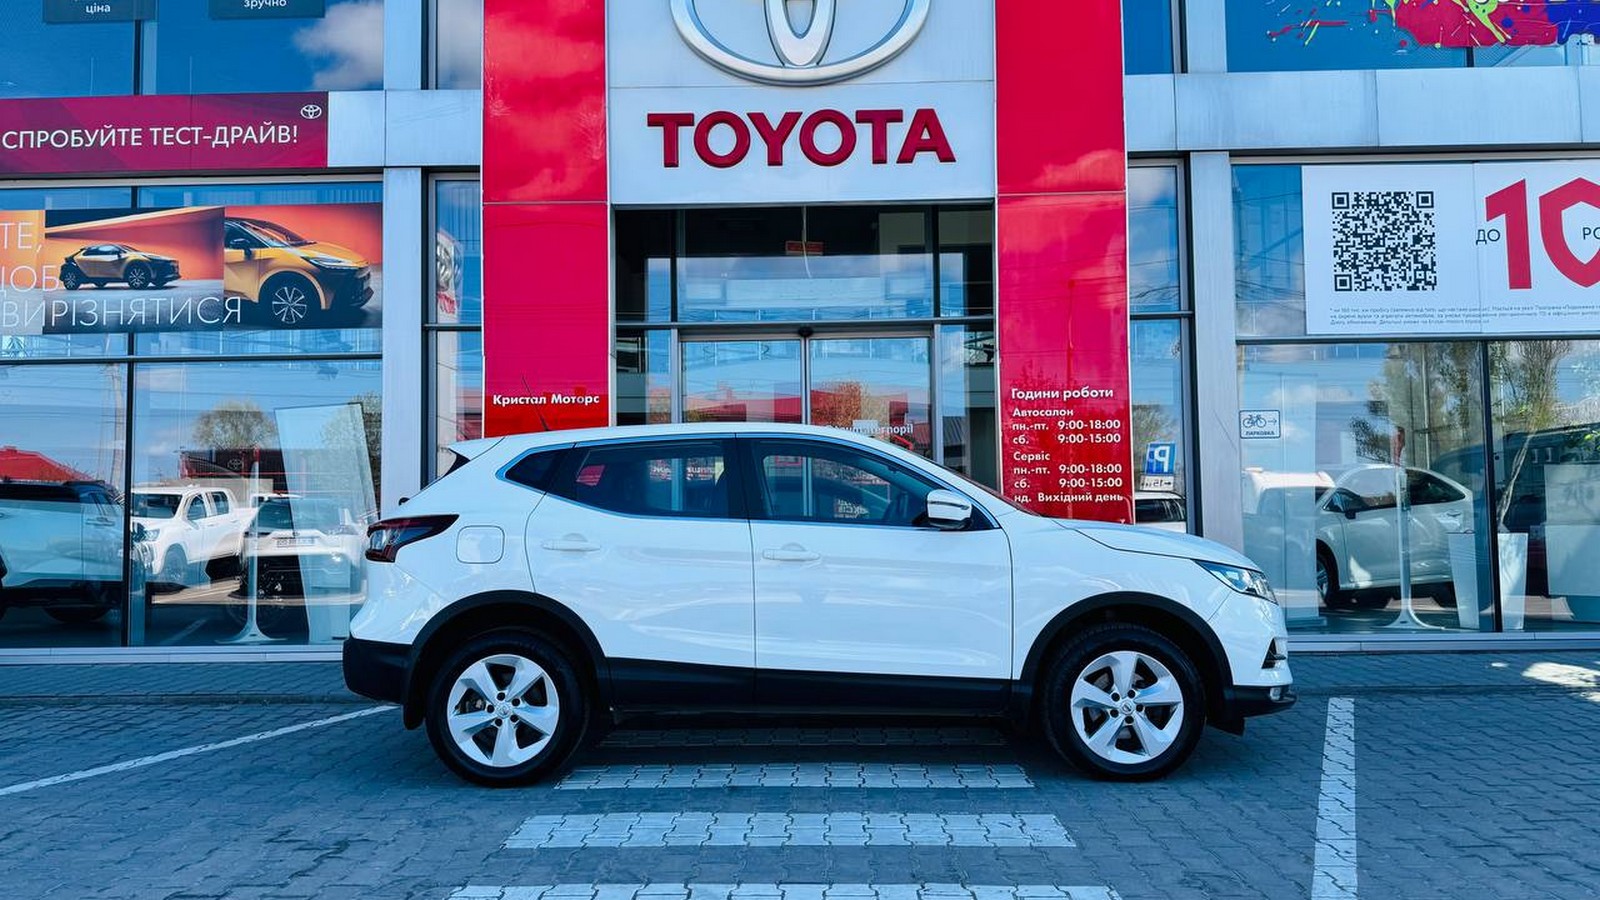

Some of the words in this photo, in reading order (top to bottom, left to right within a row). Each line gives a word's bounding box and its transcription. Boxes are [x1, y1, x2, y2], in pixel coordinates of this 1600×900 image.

[85, 2, 111, 15] ціна
[243, 0, 287, 10] зручно
[2, 124, 143, 149] СПРОБУЙТЕ
[149, 121, 299, 148] ТЕСТ-ДРАЙВ!
[647, 108, 956, 169] TOYOTA
[1475, 228, 1502, 246] ДО
[1, 296, 242, 328] ВИРІЗНЯТИСЯ
[1011, 388, 1060, 401] Години
[1063, 386, 1114, 402] роботи
[493, 394, 547, 407] Кристал
[550, 394, 600, 406] Моторс
[1012, 407, 1074, 417] Автосалон
[1012, 422, 1049, 431] пн.-пт.
[1057, 419, 1121, 430] 9:00-18:00
[1012, 434, 1029, 445] сб.
[1057, 433, 1121, 444] 9:00-15:00
[1013, 450, 1051, 462] Сервіс
[1013, 466, 1051, 475] пн.-пт.
[1058, 463, 1122, 474] 9:00-18:00
[1013, 478, 1030, 489] сб.
[1058, 477, 1123, 488] 9:00-15:00
[1014, 494, 1032, 503] нд.
[1037, 491, 1093, 503] Вихідний
[1094, 493, 1124, 503] день
